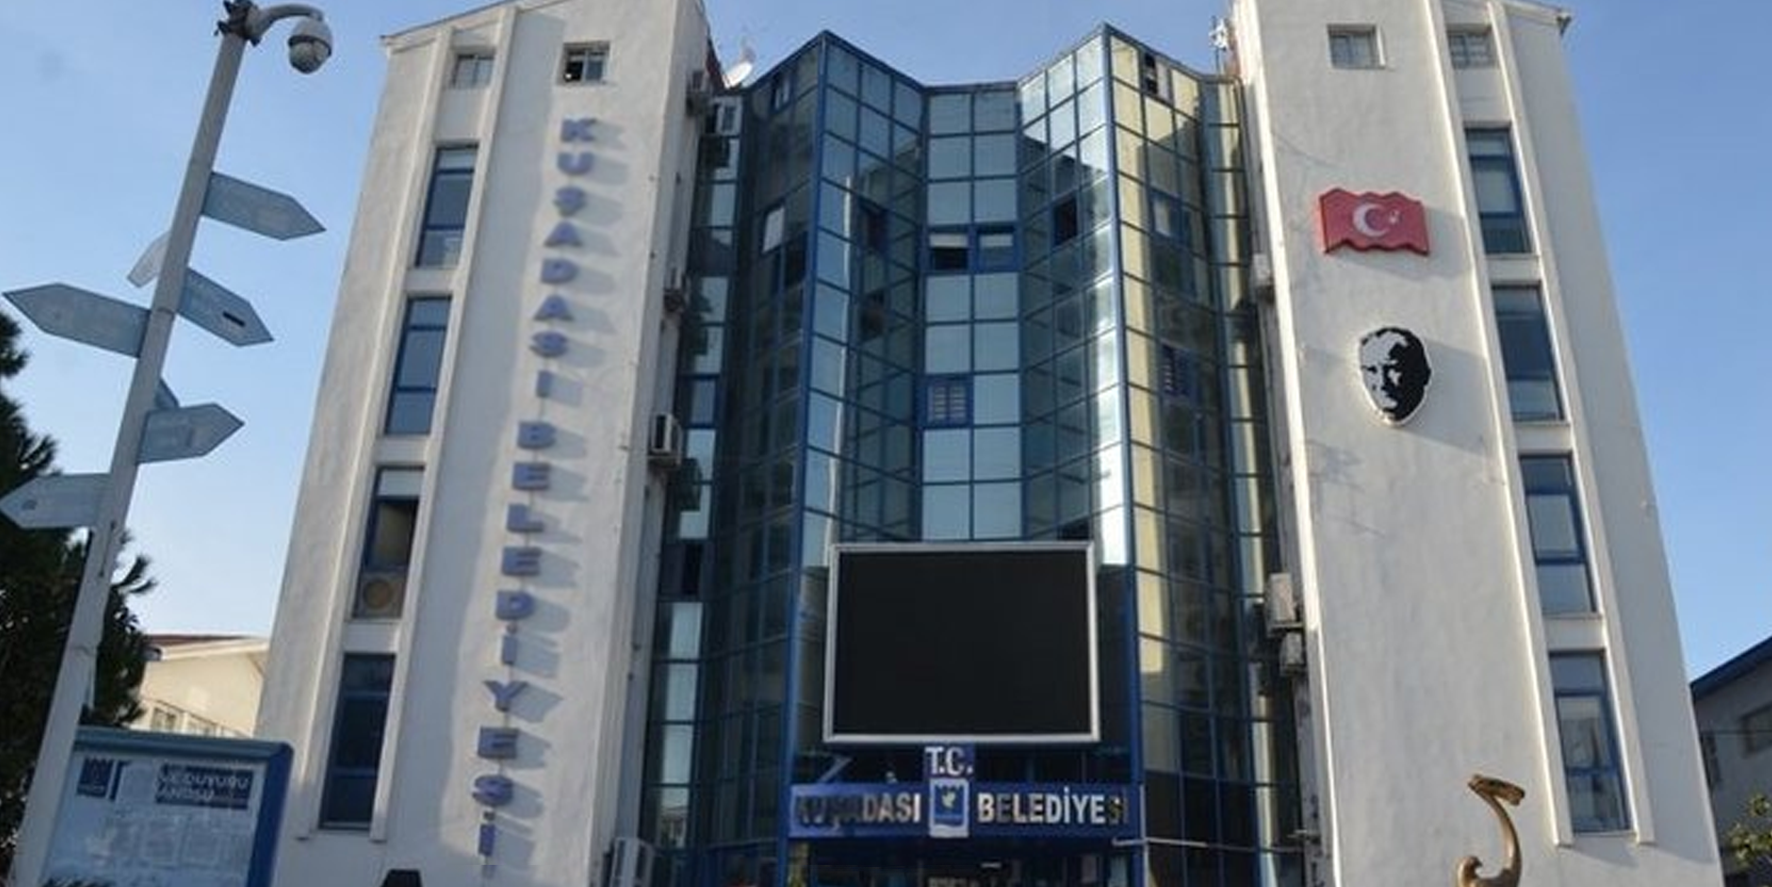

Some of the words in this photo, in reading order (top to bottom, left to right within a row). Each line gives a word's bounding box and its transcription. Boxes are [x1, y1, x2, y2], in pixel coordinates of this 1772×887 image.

[529, 117, 598, 399] KUŞADASI
[472, 420, 557, 857] BELEDİYESİ
[925, 746, 973, 776] T.C.
